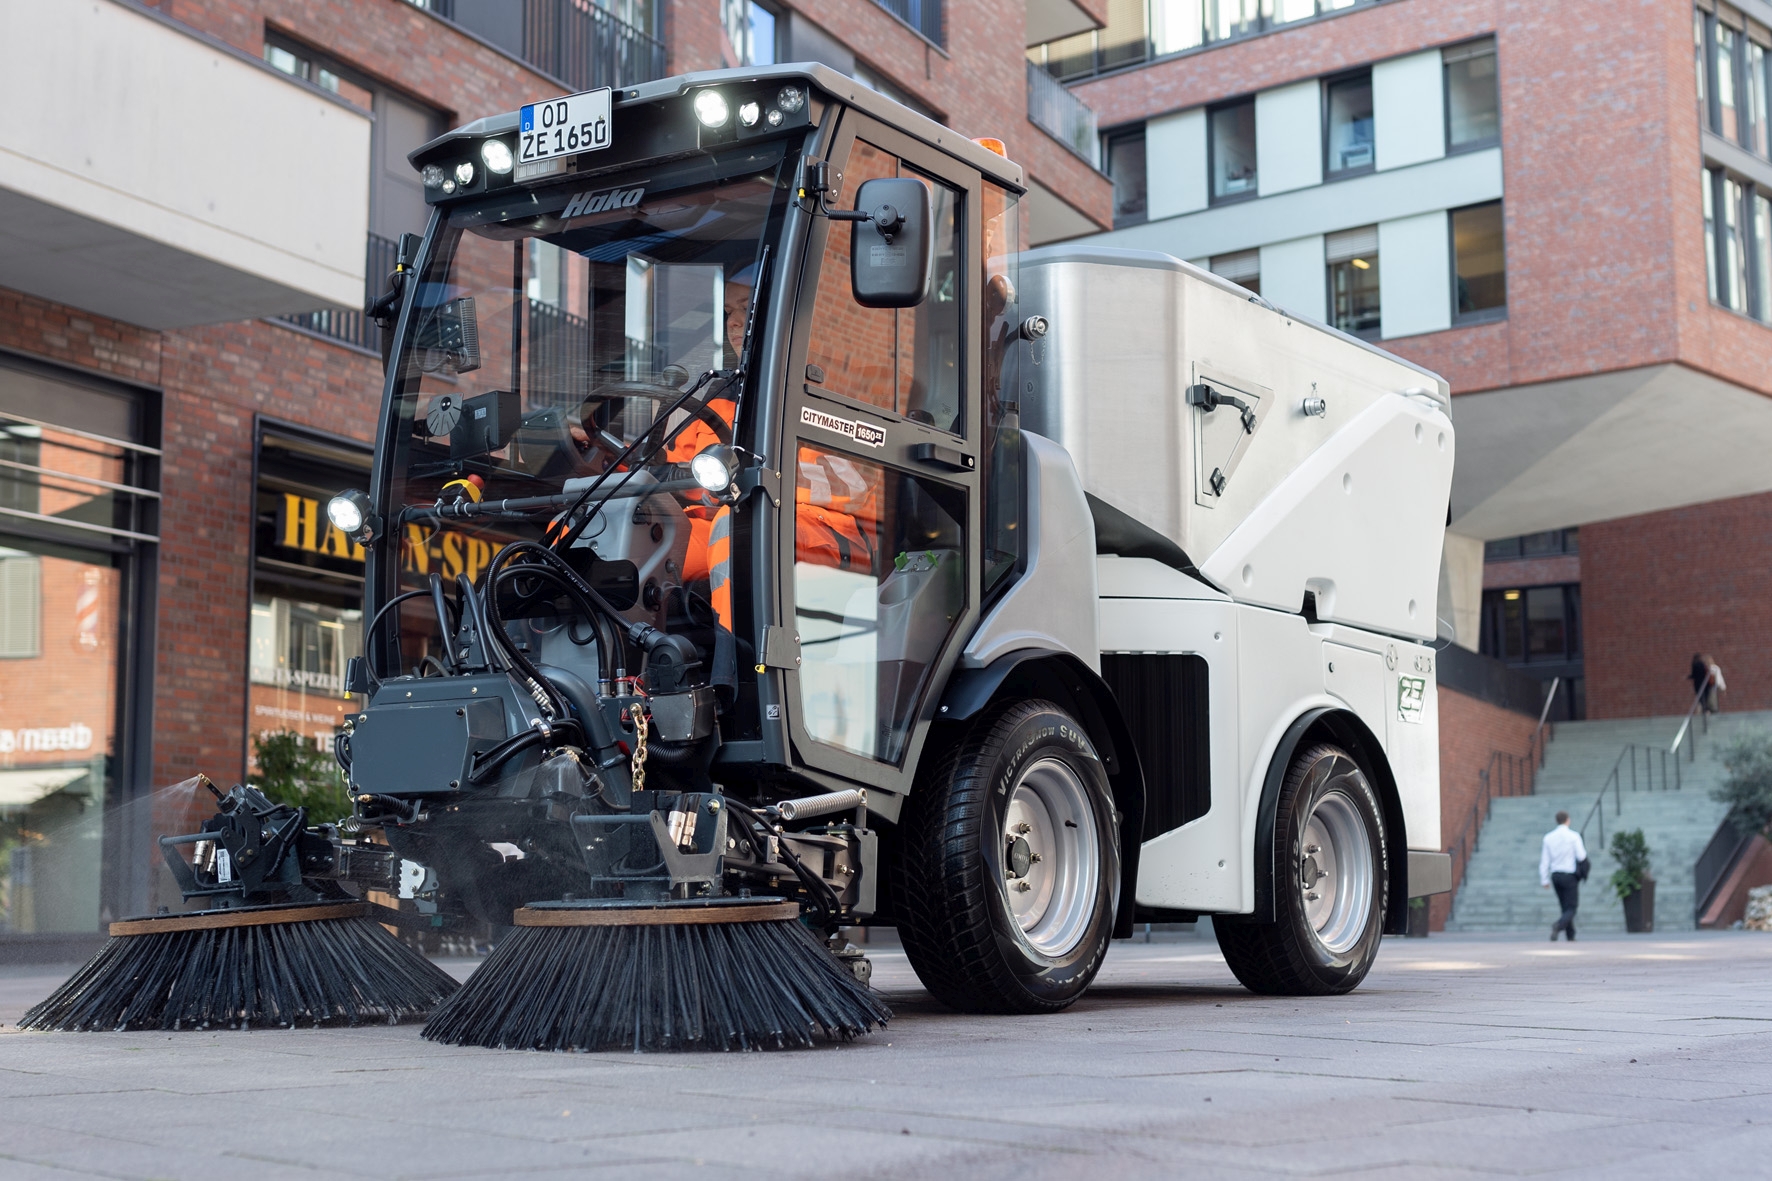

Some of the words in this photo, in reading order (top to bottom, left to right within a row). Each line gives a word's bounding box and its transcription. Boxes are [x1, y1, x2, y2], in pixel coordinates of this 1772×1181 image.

[524, 122, 531, 130] D
[542, 101, 568, 128] OD
[523, 132, 549, 159] ZE
[554, 119, 606, 153] 1650
[560, 187, 645, 219] Hako
[802, 410, 855, 435] CITYMASTER
[1060, 724, 1086, 749] SUV
